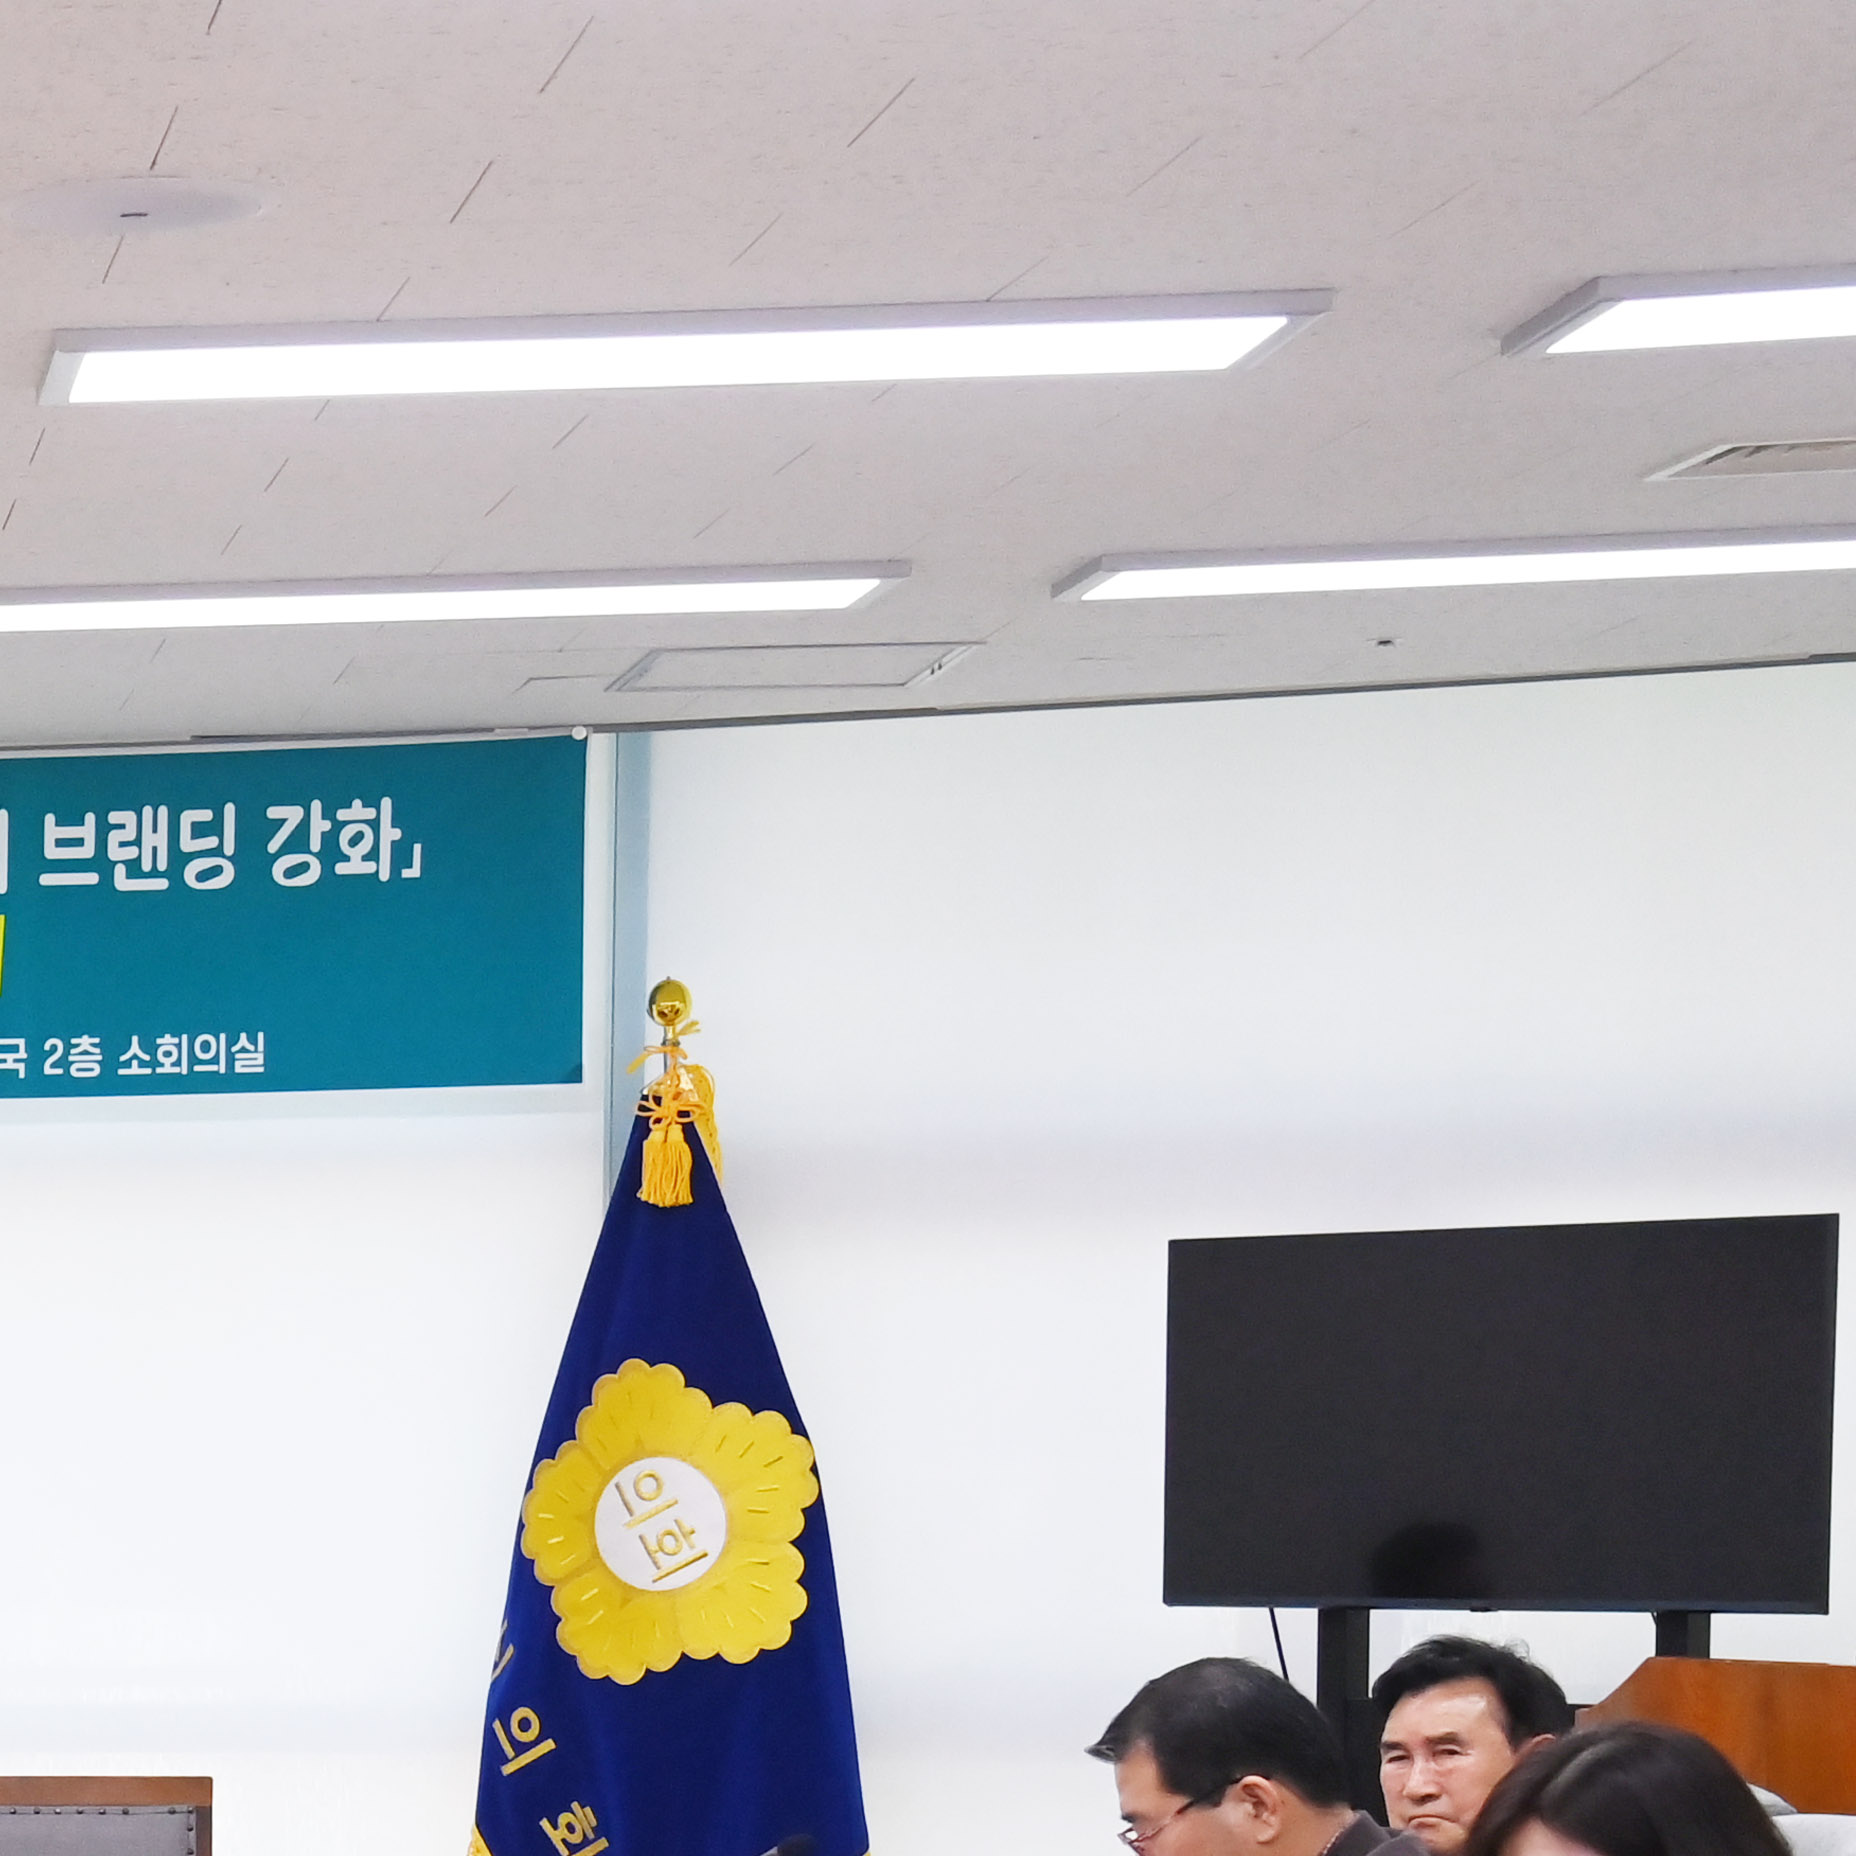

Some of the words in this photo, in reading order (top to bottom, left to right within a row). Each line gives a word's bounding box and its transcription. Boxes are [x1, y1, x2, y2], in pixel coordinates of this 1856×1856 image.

[38, 802, 236, 892] 브랜딩
[266, 796, 422, 887] 강화」
[43, 1034, 103, 1078] 2층
[117, 1031, 265, 1076] 소회의실
